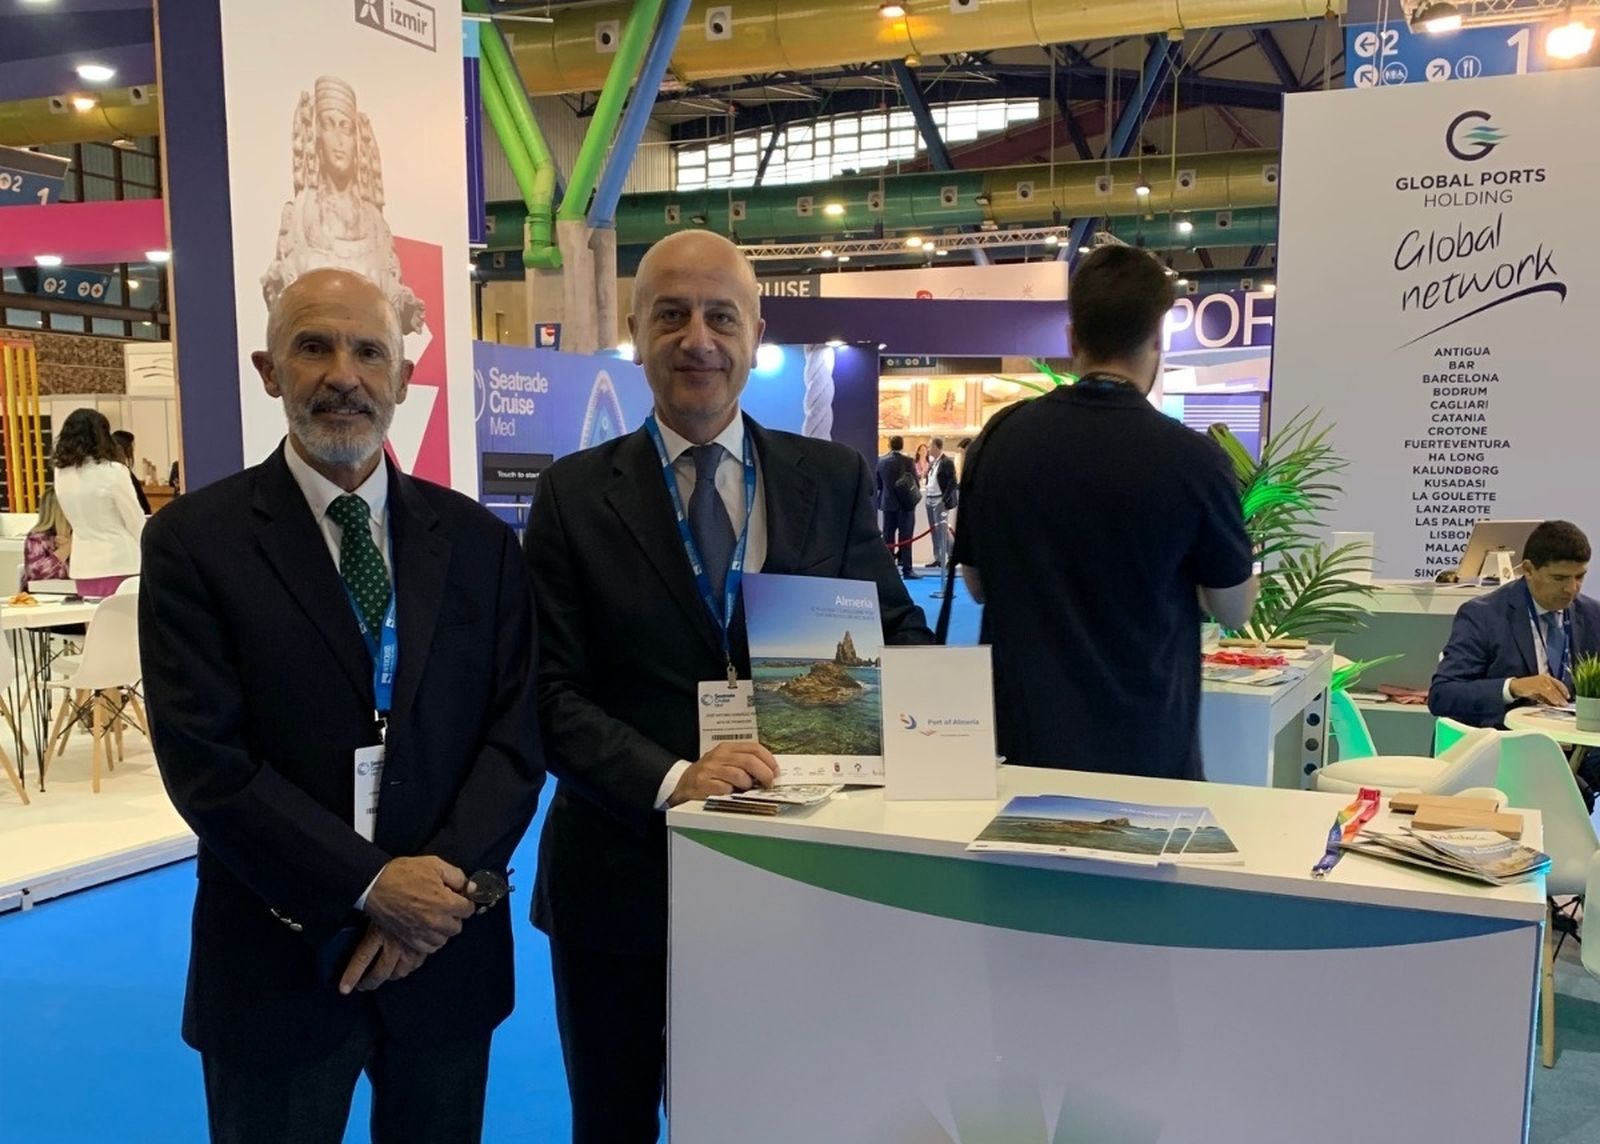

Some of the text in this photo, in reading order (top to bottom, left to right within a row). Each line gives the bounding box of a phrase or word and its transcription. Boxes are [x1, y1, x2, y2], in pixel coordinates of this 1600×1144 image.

[390, 1, 428, 36] izmir
[1382, 29, 1399, 55] 2
[1507, 28, 1530, 75] 1
[11, 175, 23, 192] 2
[1396, 168, 1546, 190] GLOBAL PORTS
[37, 187, 50, 205] 1
[1424, 189, 1513, 208] HOLDING
[1394, 212, 1503, 271] Global
[1402, 242, 1558, 311] network
[57, 279, 67, 294] 2
[1434, 347, 1491, 357] ANTIGUA
[1448, 360, 1475, 370] BAR
[489, 366, 549, 394] Seatrade
[1422, 373, 1500, 384] BARCELONA
[1433, 387, 1488, 397] BODRUM
[489, 390, 535, 416] Cruise
[1430, 400, 1489, 410] CAGLIARI
[1431, 413, 1486, 423] CATANIA
[490, 416, 516, 437] Med
[1428, 426, 1488, 436] CROTONE
[1404, 439, 1511, 449] FUERTEVENTURA
[1428, 452, 1485, 462] HA LONG
[497, 470, 517, 479] Touch
[517, 471, 525, 479] to
[1412, 465, 1500, 476] KALUNDBORG
[1424, 478, 1486, 488] KUSADASI
[1412, 491, 1497, 502] LA GOULETTE
[1416, 504, 1491, 515] LANZAROTE
[1415, 517, 1491, 527] LAS PALM
[927, 718, 942, 726] Port
[944, 718, 951, 726] of
